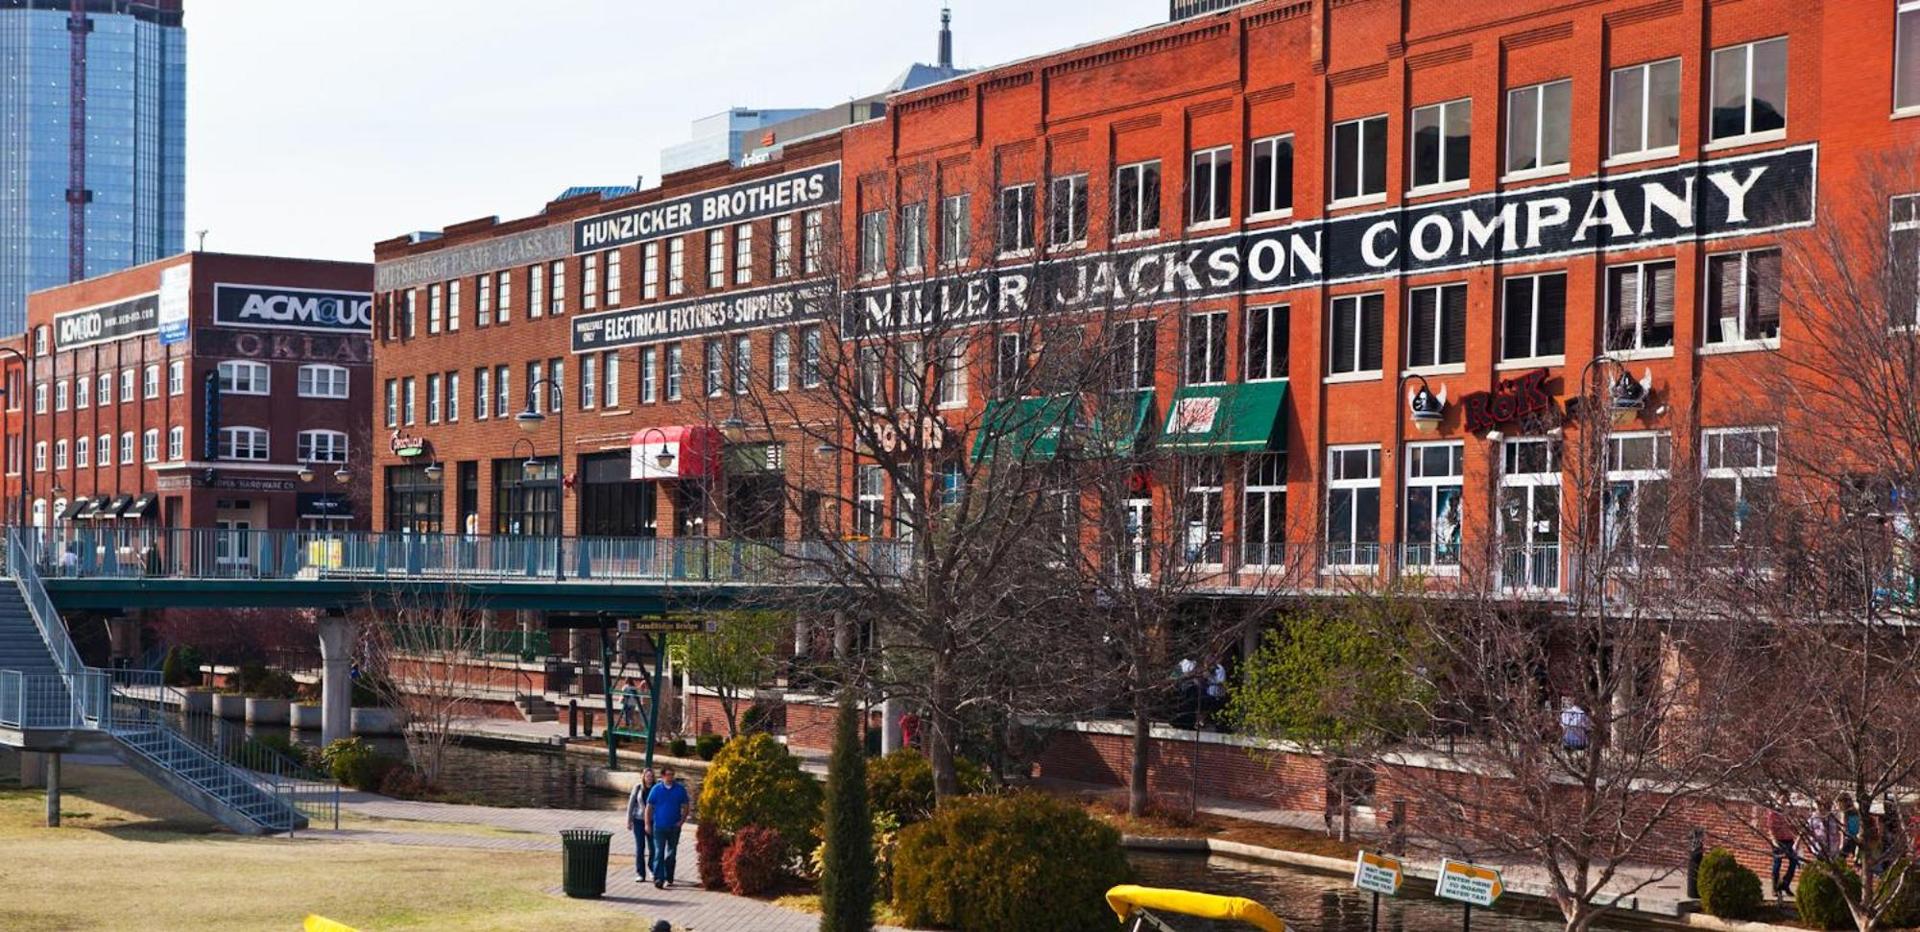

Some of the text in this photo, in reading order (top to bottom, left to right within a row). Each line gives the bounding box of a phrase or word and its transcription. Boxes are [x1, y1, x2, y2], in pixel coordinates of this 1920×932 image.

[583, 174, 824, 247] HUNZICKER BROTHERS
[379, 256, 448, 286] PITTSBURGH
[500, 234, 542, 263] GLASS
[866, 166, 1769, 331] MILLER JACKSON COMPANY
[605, 310, 668, 341] ELECTRICAL
[670, 301, 726, 332] FIXTURES
[735, 291, 794, 322] SUPPLIES
[1446, 888, 1487, 901] WATER TAXI
[1447, 875, 1491, 888] ENTER HERE
[1462, 884, 1486, 894] BOARD
